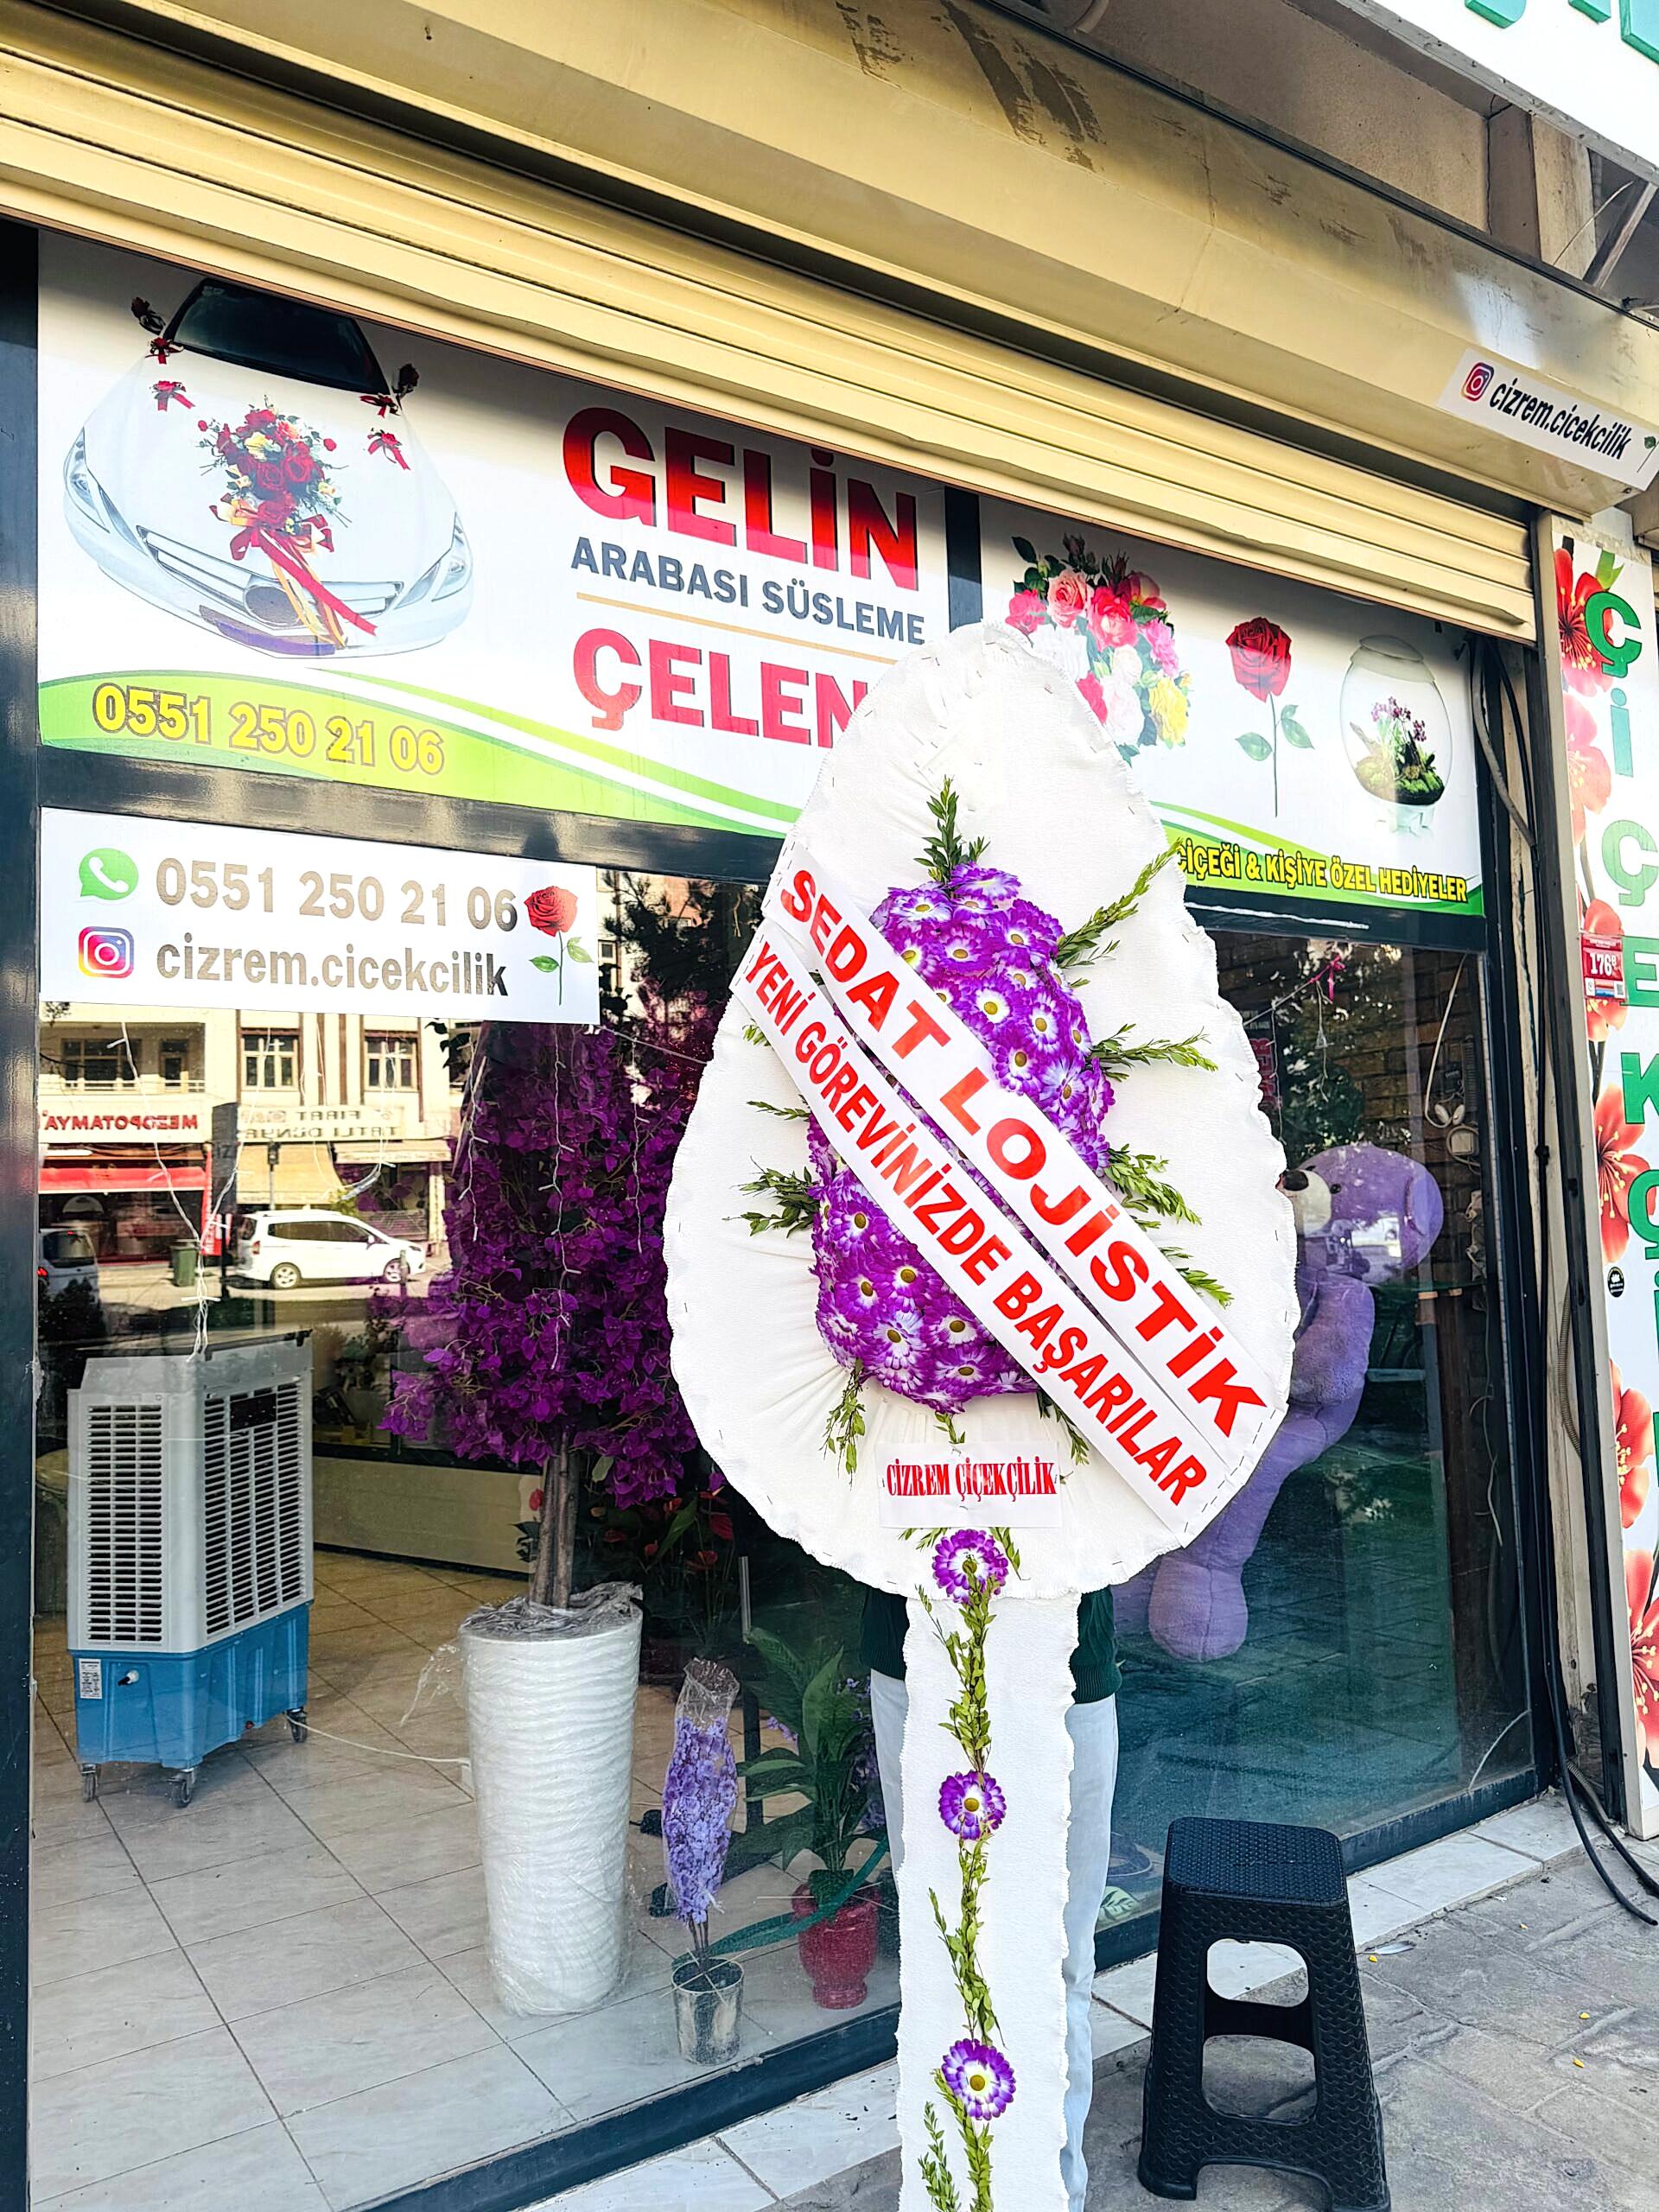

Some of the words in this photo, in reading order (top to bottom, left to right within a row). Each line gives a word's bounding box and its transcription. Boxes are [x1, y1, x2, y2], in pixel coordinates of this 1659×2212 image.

[1489, 378, 1632, 460] cizrem.cicekcilik
[563, 407, 919, 591] GELİN
[570, 537, 749, 607] ARABASI
[761, 578, 925, 645] SÜSLEME
[92, 682, 213, 745] 0551
[228, 701, 316, 759] 250
[326, 715, 376, 767] 21
[389, 721, 445, 775] 06
[573, 627, 868, 749] ÇELEN
[156, 857, 275, 913] 0551
[299, 870, 385, 922] 250
[400, 879, 447, 927] 21
[467, 886, 518, 932] 06
[1245, 851, 1263, 881] &
[1265, 849, 1327, 889] KİŞİYE
[1330, 855, 1376, 893] ÖZEL
[1378, 865, 1468, 903] HEDİYELER
[156, 931, 509, 997] cizrem.cicekcilik
[780, 868, 951, 1062] SEDAT
[939, 1066, 1268, 1438] LOJİSTİK
[746, 941, 817, 1036] YENİ
[795, 1020, 1013, 1287] GÖREVİNİZDE
[994, 1270, 1209, 1507] BAŞARILAR
